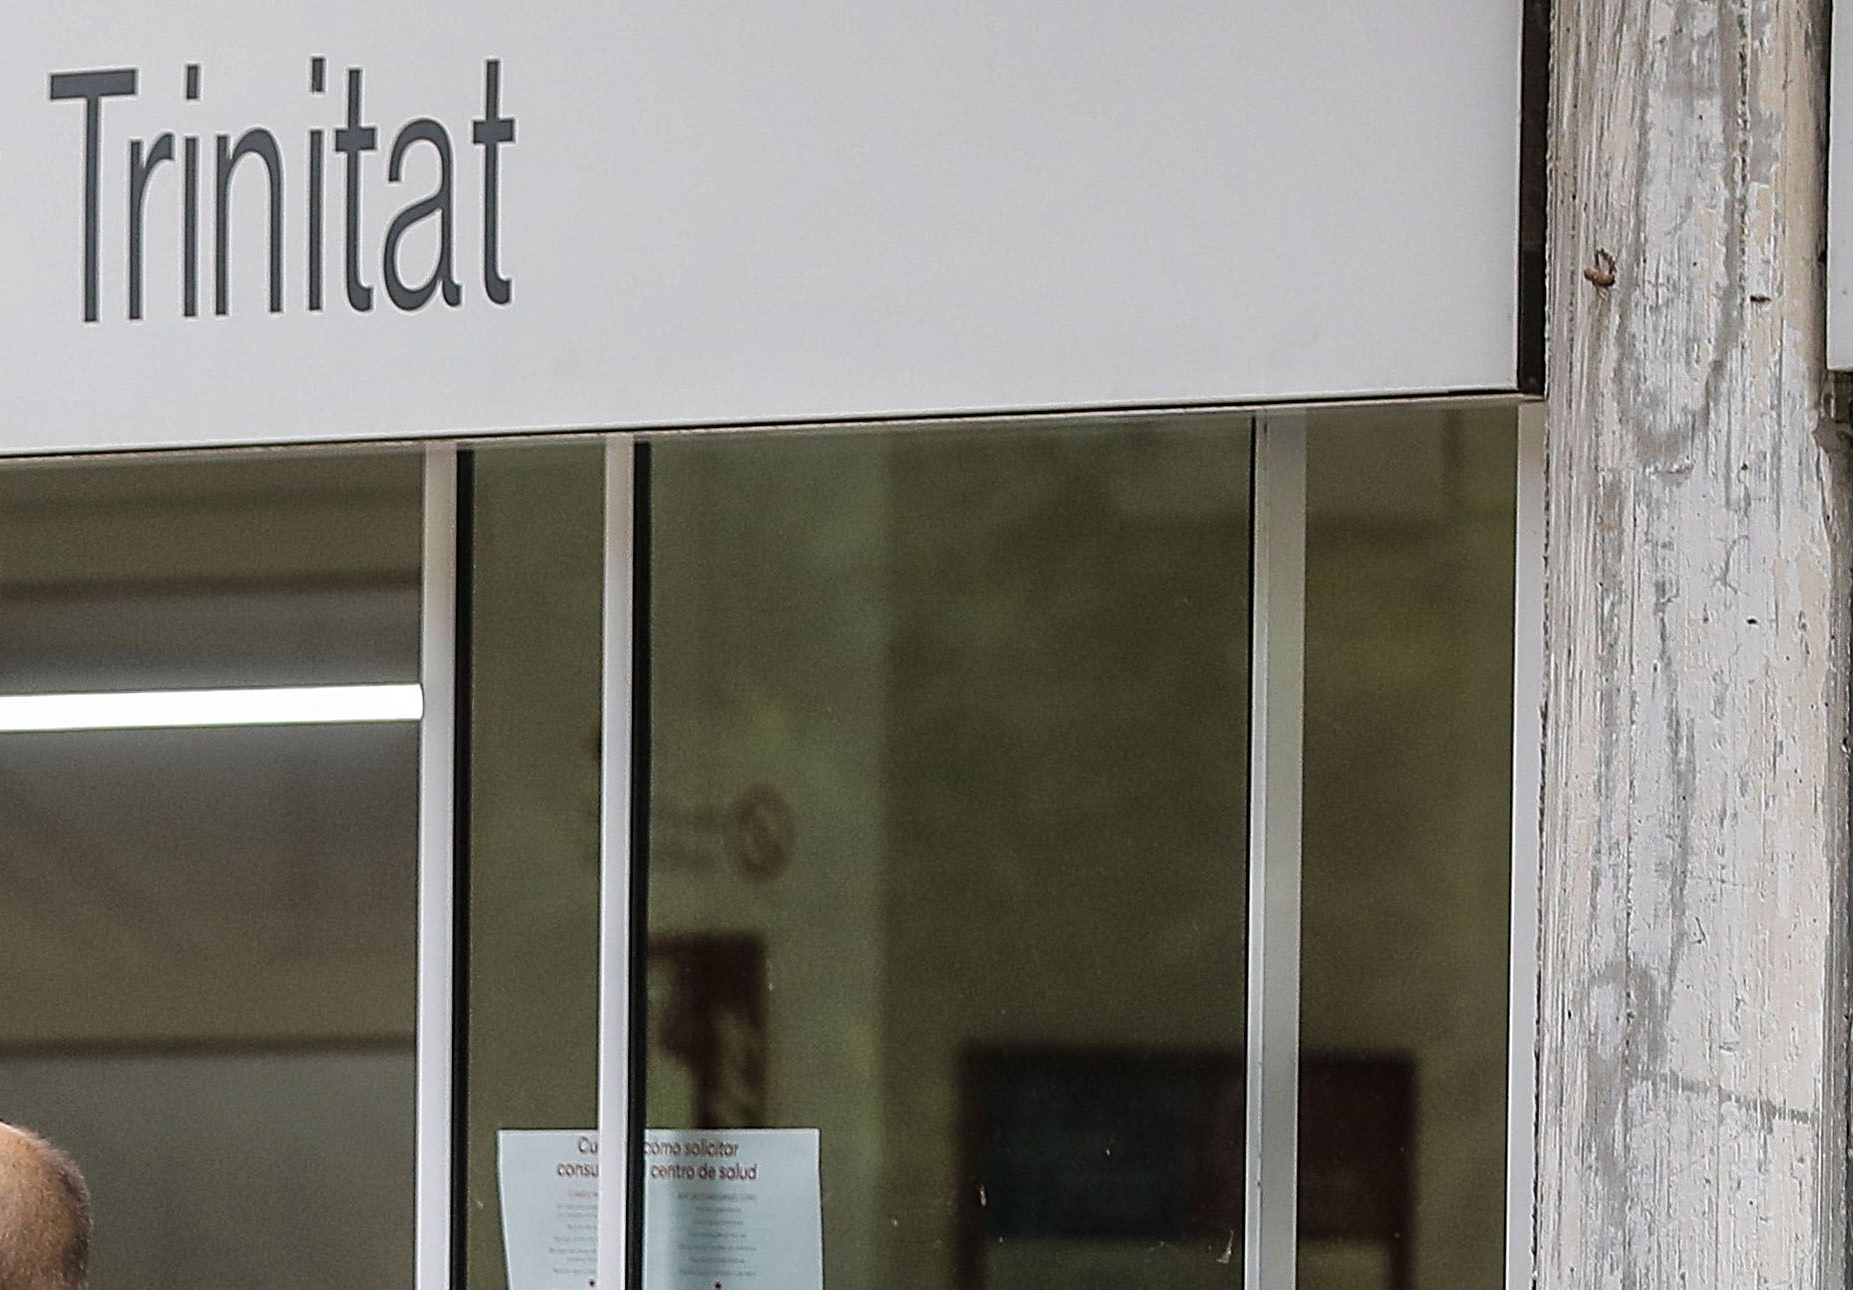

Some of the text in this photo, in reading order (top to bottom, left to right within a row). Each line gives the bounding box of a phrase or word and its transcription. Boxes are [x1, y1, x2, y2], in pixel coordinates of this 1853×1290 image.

[47, 56, 517, 325] Trinitat
[651, 1163, 695, 1178] centro
[698, 1162, 717, 1178] de
[720, 1162, 758, 1180] salud
